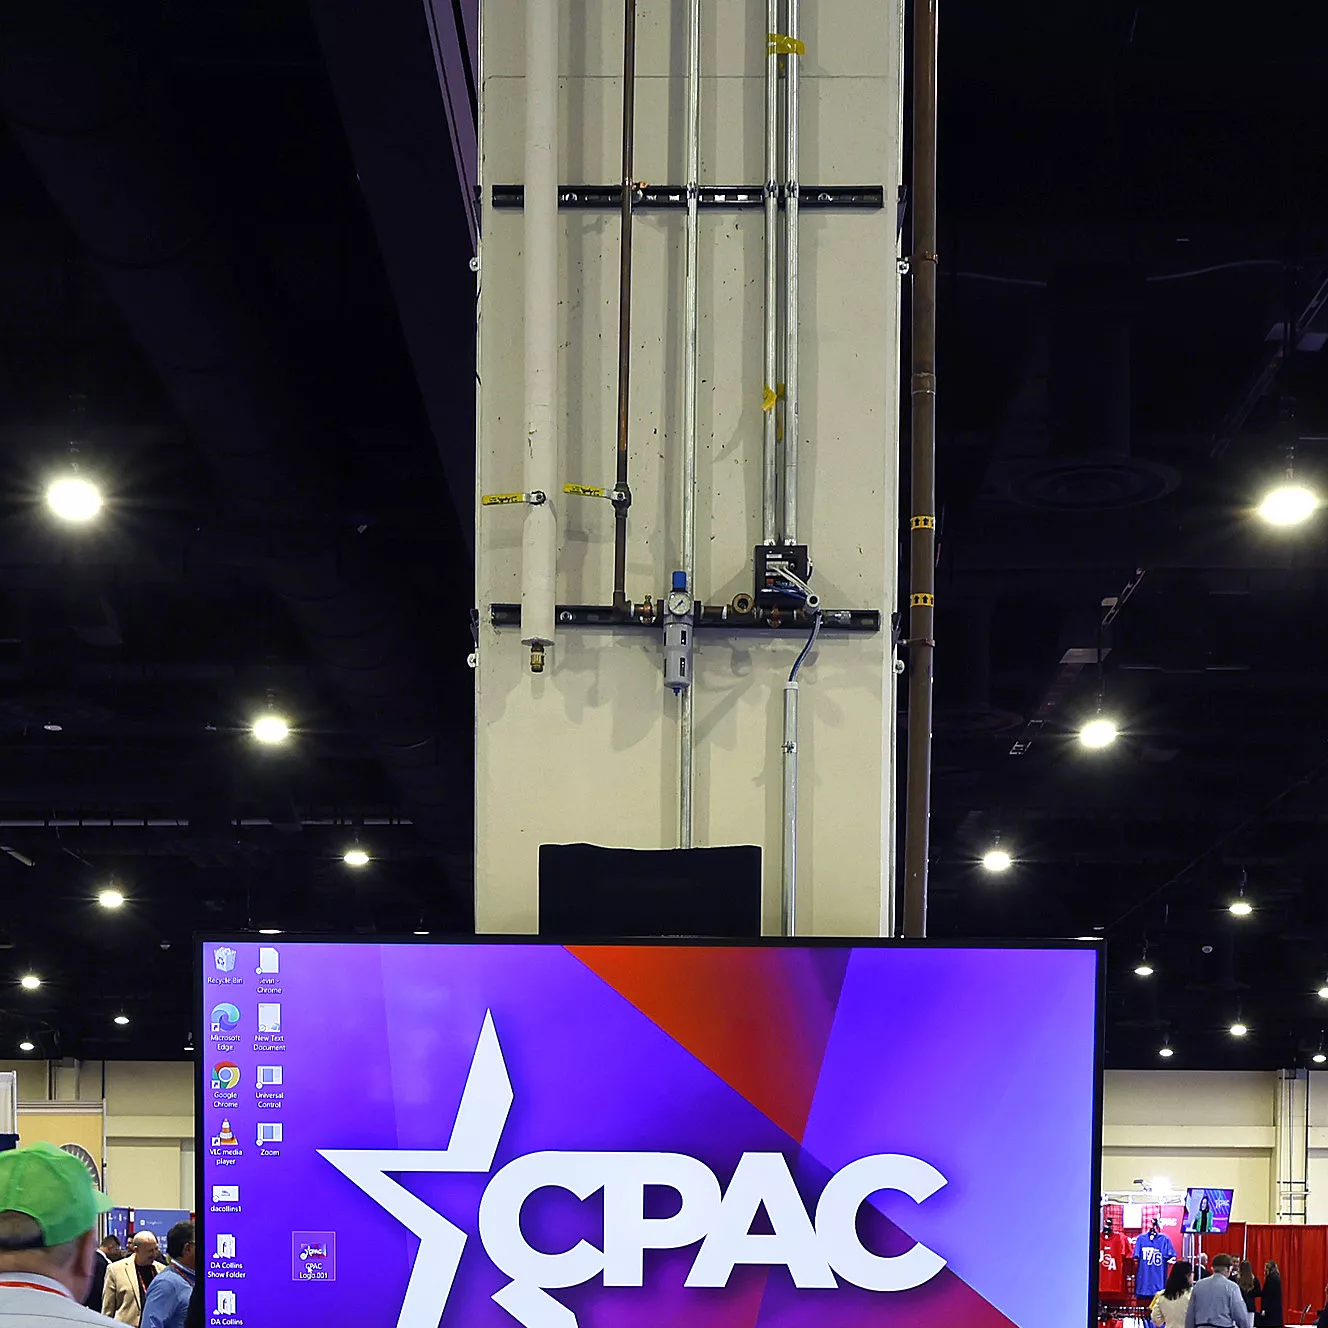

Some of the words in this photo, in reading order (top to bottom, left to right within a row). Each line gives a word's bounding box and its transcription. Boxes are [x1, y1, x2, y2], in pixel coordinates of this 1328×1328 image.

[207, 977, 231, 986] Recycle
[210, 1034, 241, 1042] Microsoft
[254, 1034, 269, 1042] New
[270, 1034, 284, 1042] Text
[217, 1044, 234, 1052] Edge
[213, 1091, 238, 1100] Google
[209, 1148, 222, 1156] VLC
[222, 1148, 243, 1156] media
[216, 1158, 236, 1166] player
[479, 1150, 949, 1292] CPAC
[221, 1261, 243, 1269] Collins
[210, 1318, 221, 1326] DA
[221, 1318, 244, 1326] Collins
